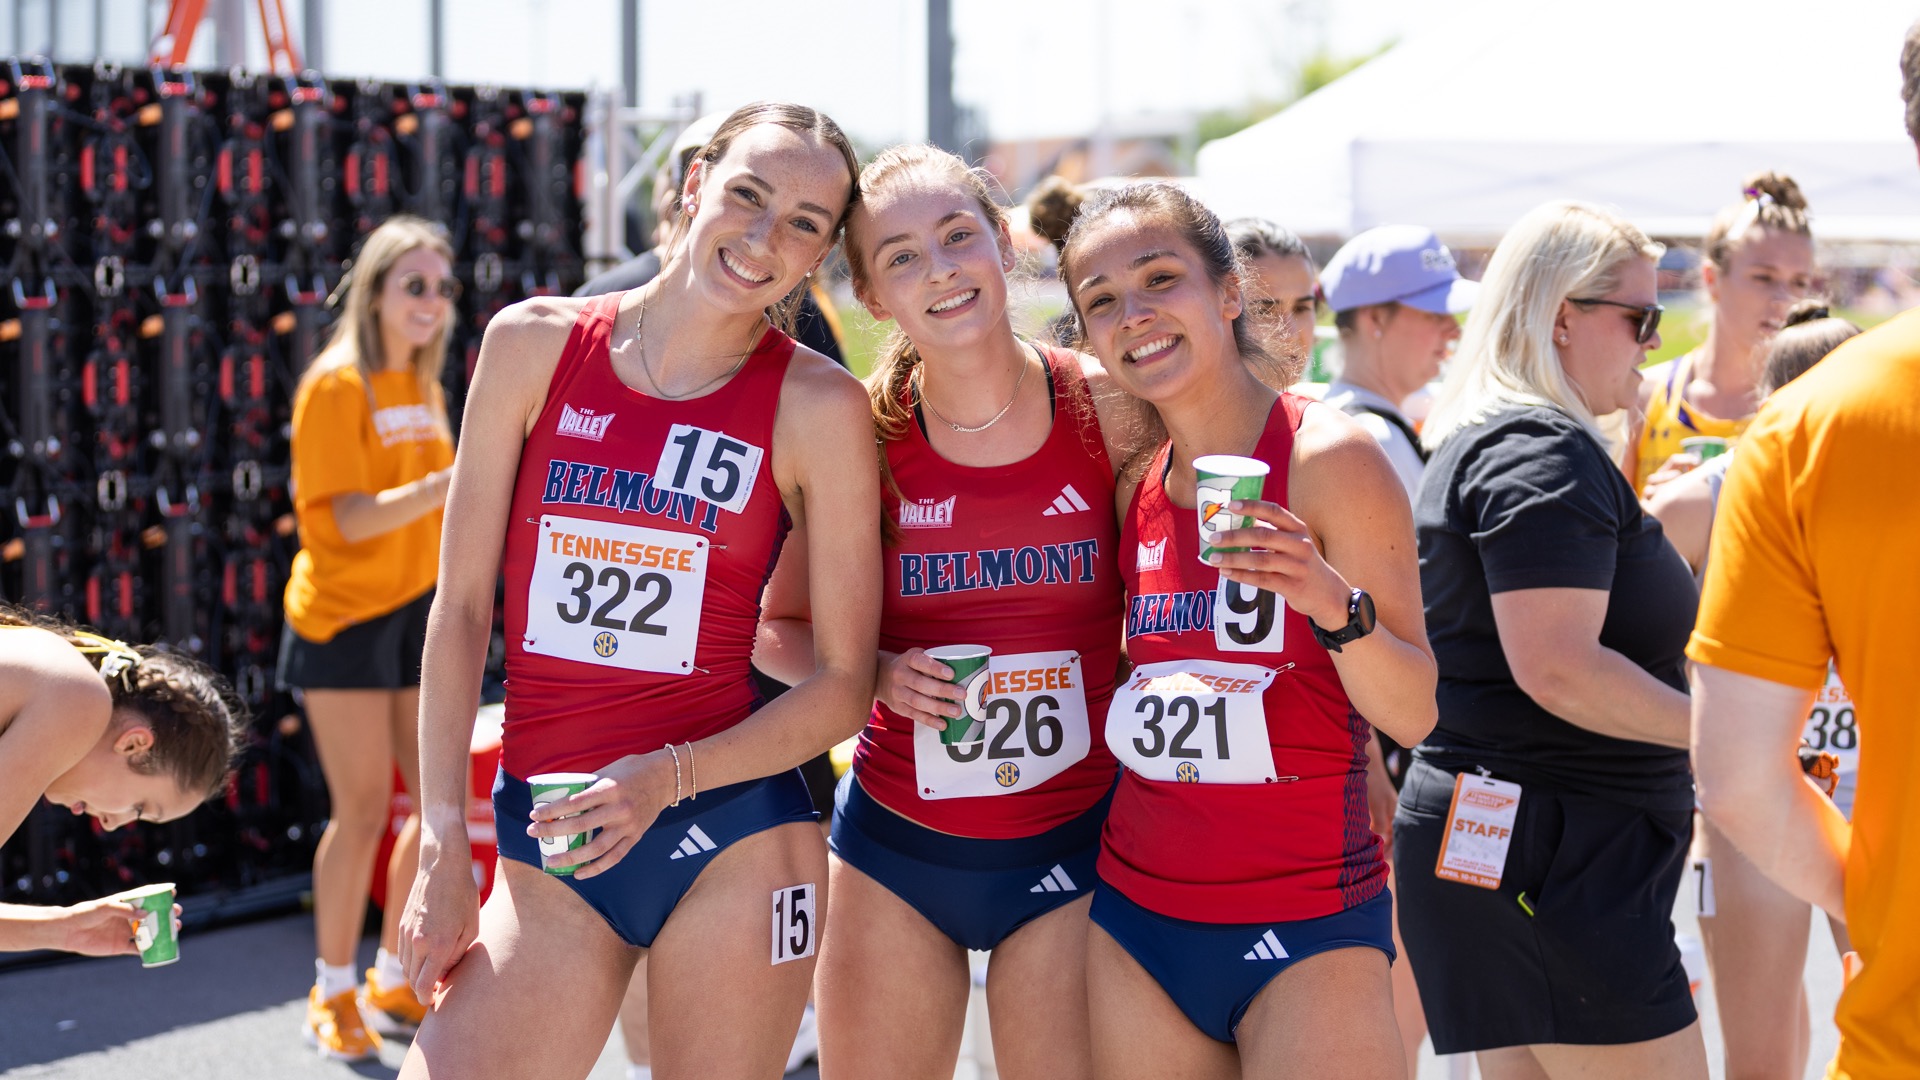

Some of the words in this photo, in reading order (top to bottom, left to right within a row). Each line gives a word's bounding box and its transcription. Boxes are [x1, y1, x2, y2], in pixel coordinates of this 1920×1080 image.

[559, 403, 616, 437] VALLEY
[579, 407, 596, 416] THE
[671, 429, 748, 503] 15
[900, 495, 957, 524] VALLEY
[549, 532, 696, 573] TENNESSEE
[899, 538, 1100, 597] BELMONT
[556, 562, 672, 637] 322
[1225, 578, 1276, 645] 9
[594, 633, 618, 657] SEC
[946, 694, 1064, 763] 26
[1132, 695, 1231, 760] 321
[996, 762, 1020, 787] SEC
[1455, 818, 1511, 841] STAFF
[1439, 868, 1460, 878] APRIL
[775, 888, 809, 959] 15
